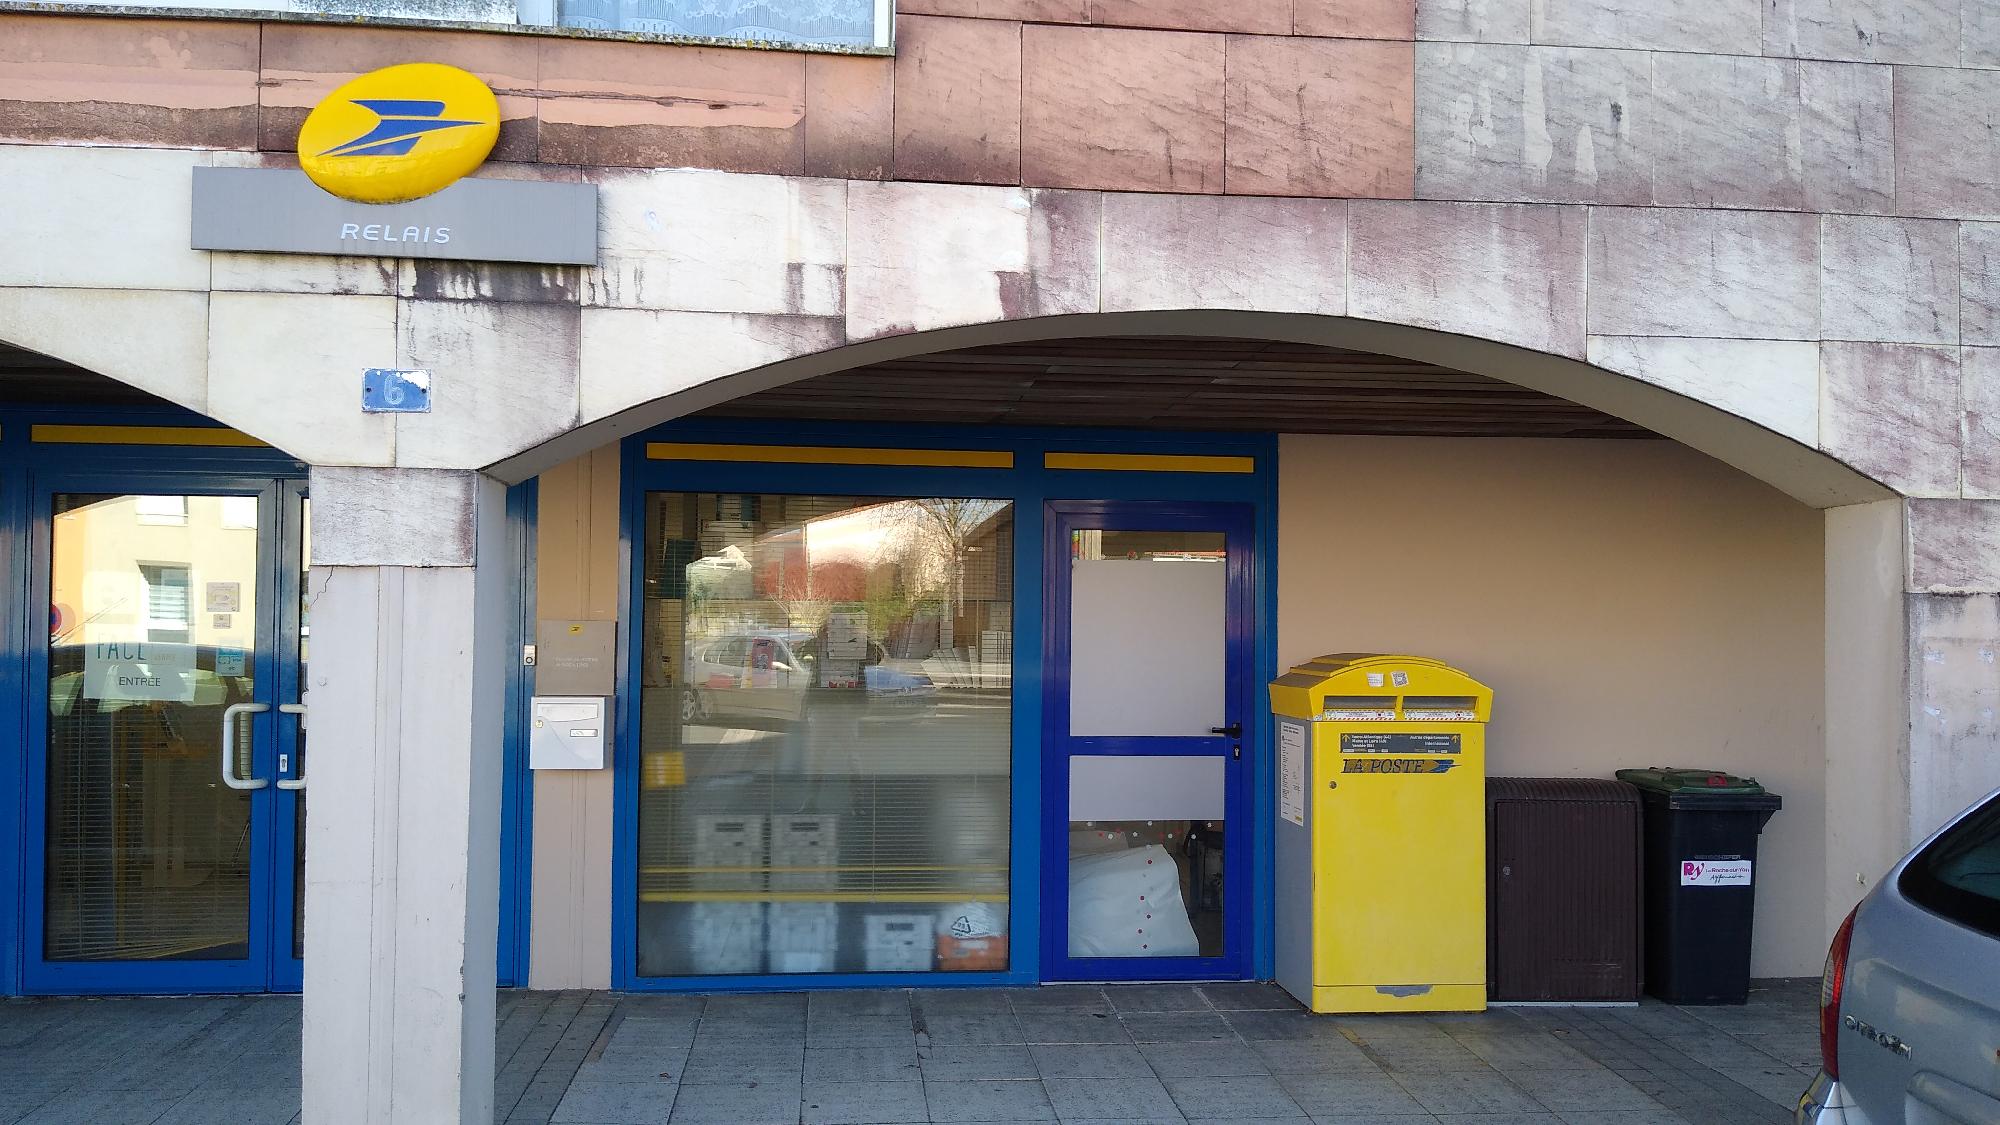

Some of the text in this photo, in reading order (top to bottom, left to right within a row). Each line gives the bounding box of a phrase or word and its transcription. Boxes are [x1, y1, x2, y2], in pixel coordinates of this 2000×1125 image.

[340, 223, 450, 244] RELAIS
[383, 373, 405, 405] 6
[1341, 759, 1425, 773] LA POSTE
